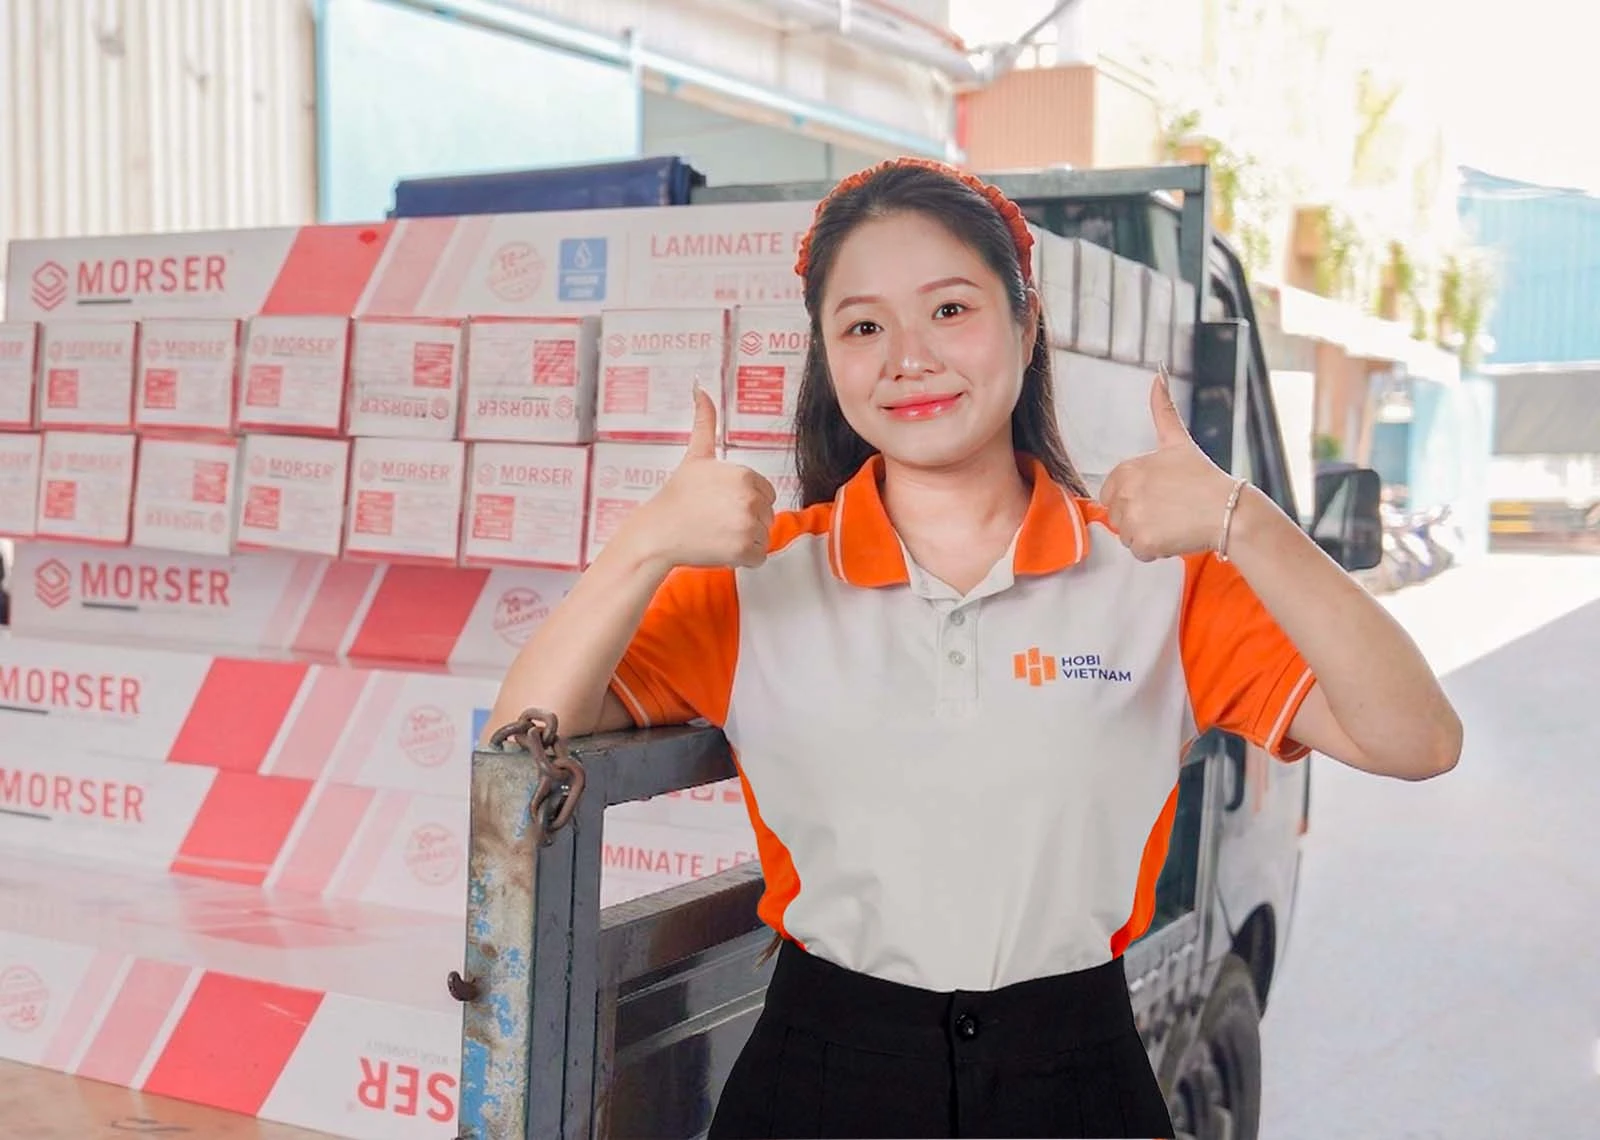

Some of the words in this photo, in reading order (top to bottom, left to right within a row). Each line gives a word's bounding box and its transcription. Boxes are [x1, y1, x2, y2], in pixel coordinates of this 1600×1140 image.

[650, 231, 784, 258] LAMINATE
[76, 255, 227, 294] MORSER
[272, 337, 337, 354] MORSER
[631, 332, 713, 352] MORSER
[476, 399, 550, 417] MORSER
[269, 459, 333, 478] MORSER
[381, 463, 449, 482] MORSER
[500, 465, 574, 487] MORSER
[81, 561, 230, 606] MORSER
[1061, 655, 1101, 667] HOBI
[1062, 668, 1132, 682] VIETNAM
[0, 666, 141, 714] MORSER
[0, 768, 144, 823] MORSER
